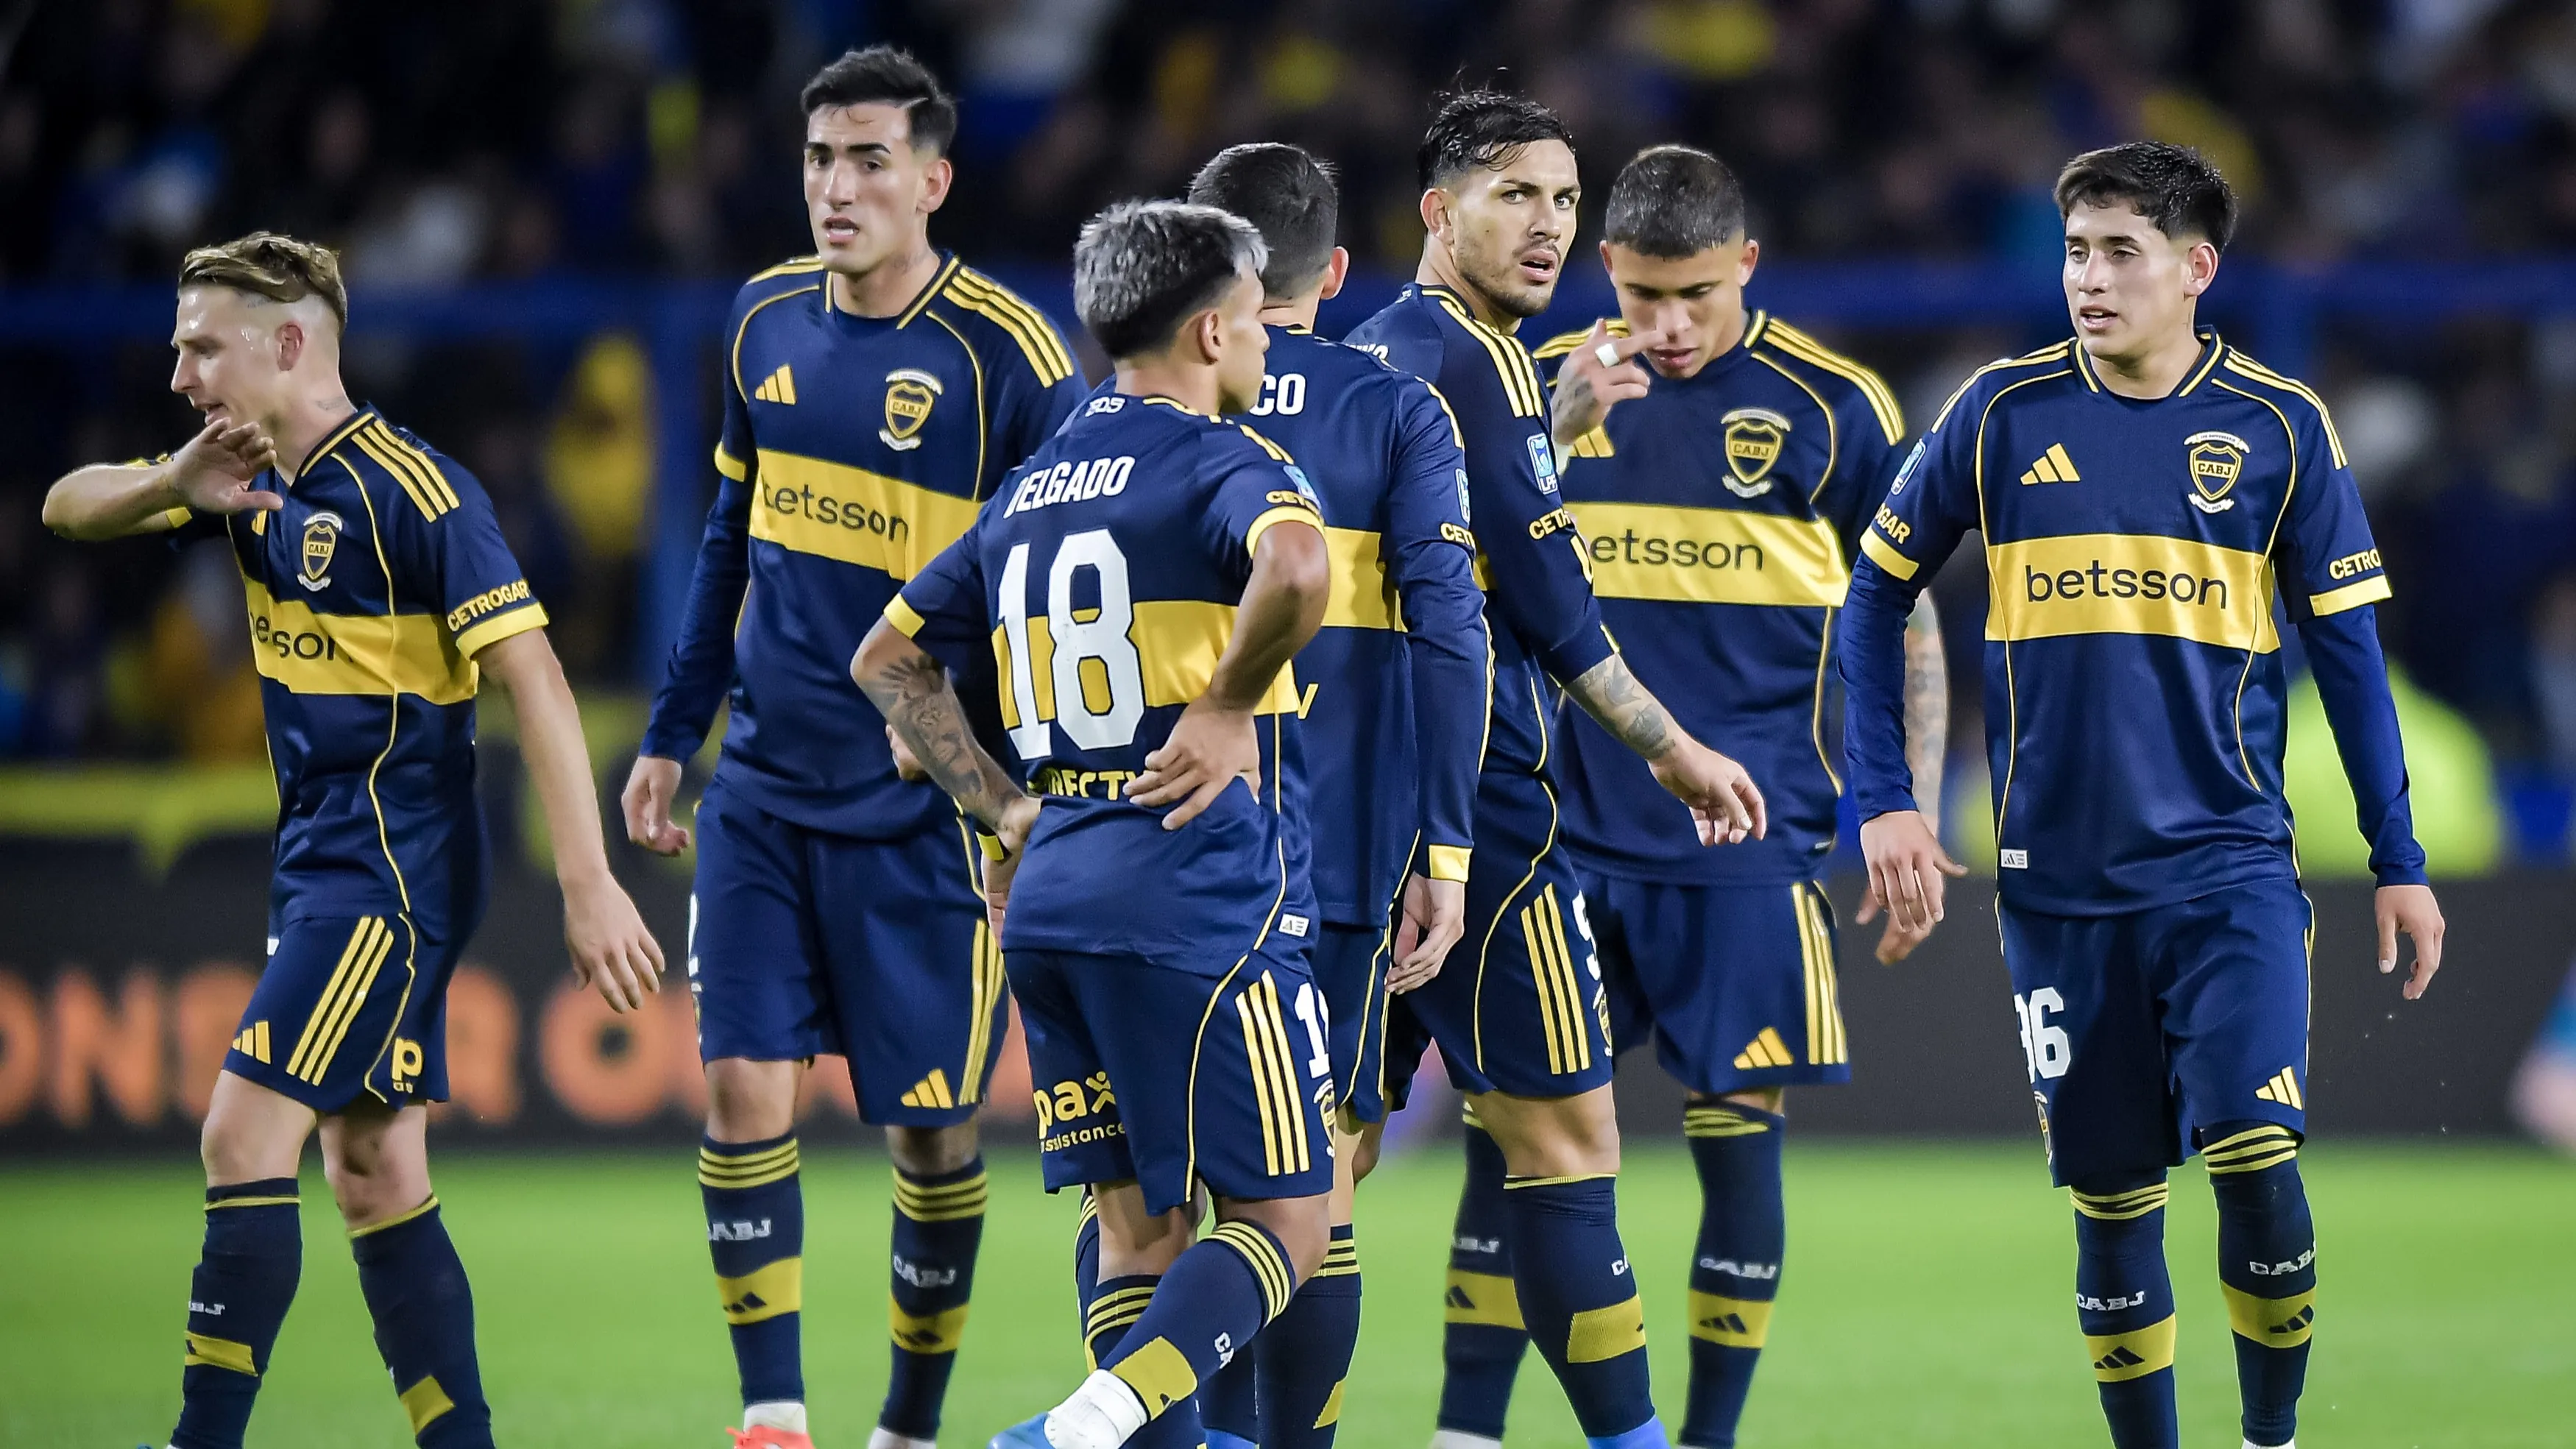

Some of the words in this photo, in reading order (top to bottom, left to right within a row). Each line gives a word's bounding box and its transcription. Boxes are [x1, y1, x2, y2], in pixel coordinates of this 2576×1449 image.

[892, 401, 921, 415] CABJ
[1734, 444, 1769, 456] CABJ
[1002, 456, 1136, 520] DELGADO
[2198, 463, 2232, 476] CABJ
[308, 545, 329, 555] CABJ
[1590, 528, 1764, 572] etsson
[2025, 559, 2227, 610] betsson
[447, 580, 530, 631] CETROGAR
[998, 528, 1145, 761] 18
[1033, 1071, 1117, 1140] pax
[708, 1219, 771, 1241] ABJ
[2249, 1239, 2316, 1276] CAB
[2076, 1291, 2145, 1311] CABJ
